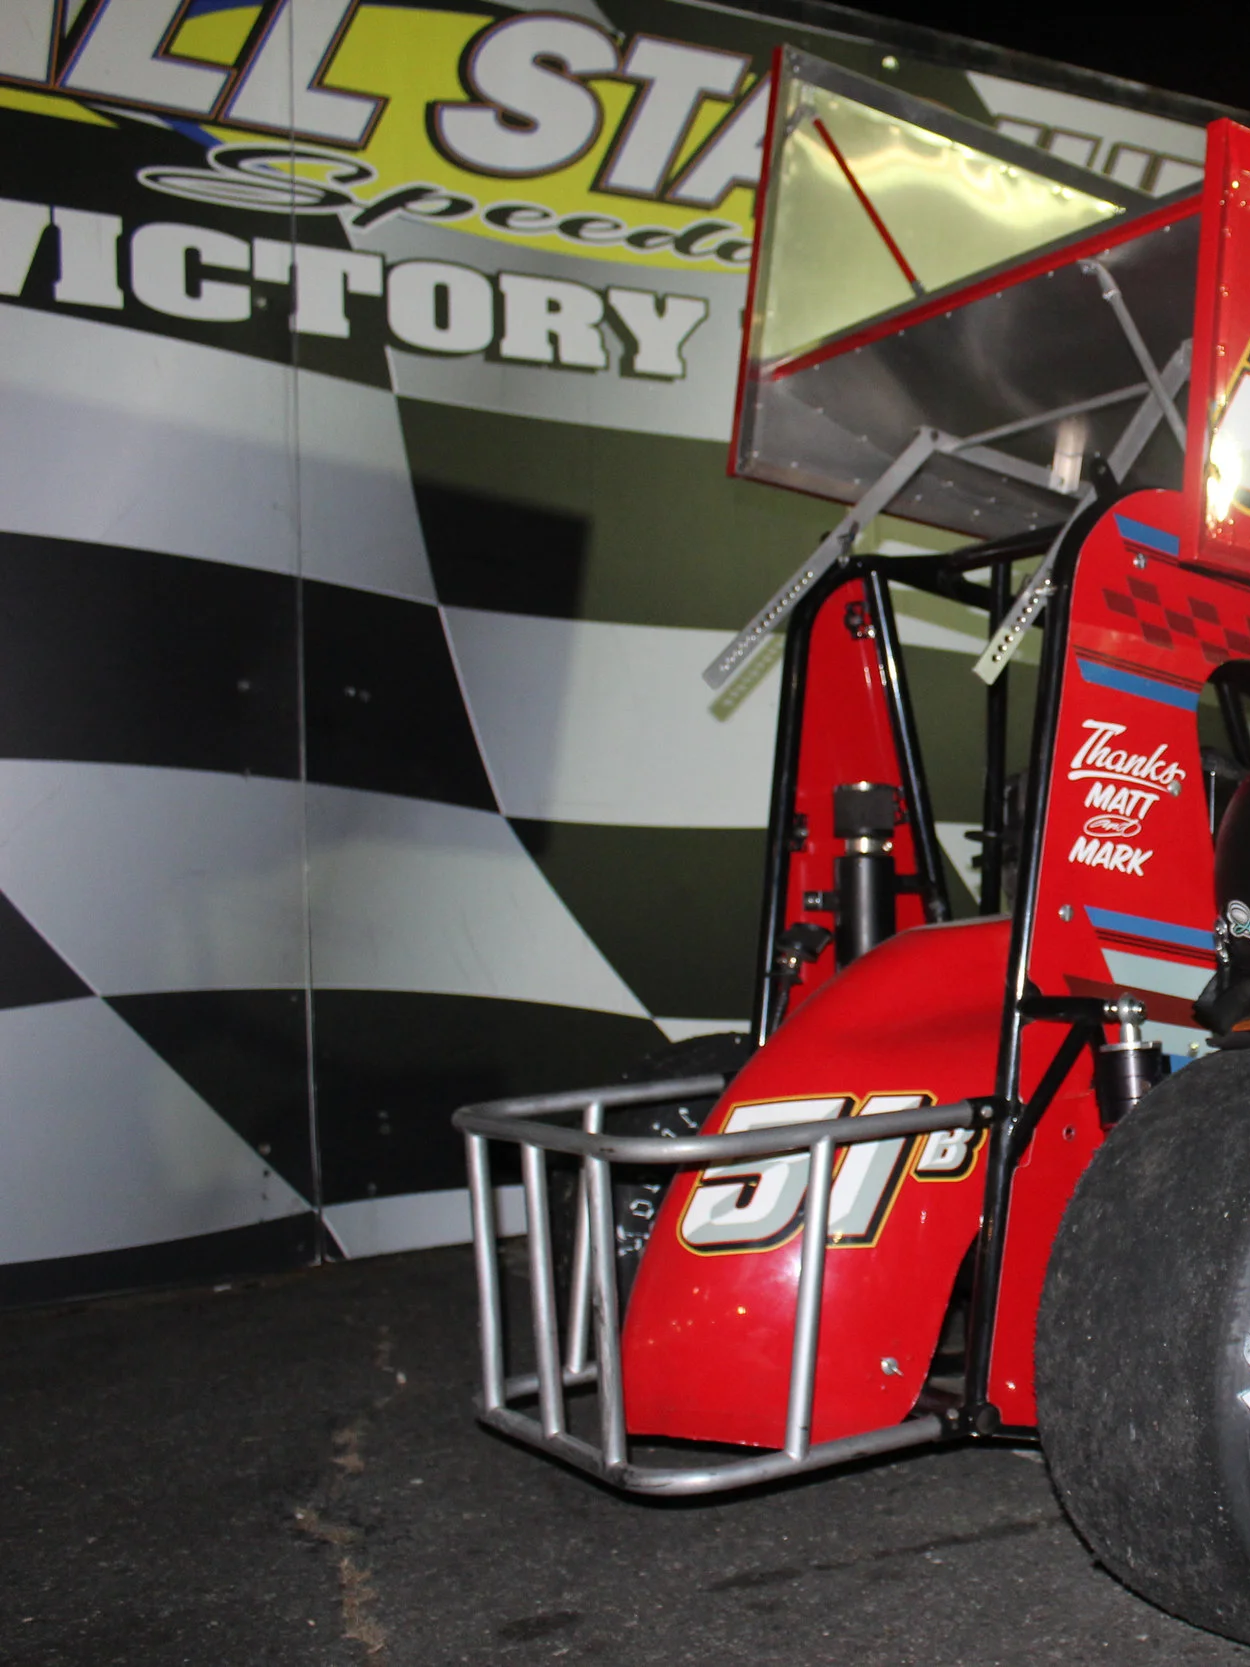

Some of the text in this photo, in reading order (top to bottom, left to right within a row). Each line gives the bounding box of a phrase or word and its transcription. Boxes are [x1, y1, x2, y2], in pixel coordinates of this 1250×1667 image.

[1070, 719, 1186, 785] Thanks
[1084, 781, 1160, 819] MATT
[1068, 836, 1153, 877] MARK
